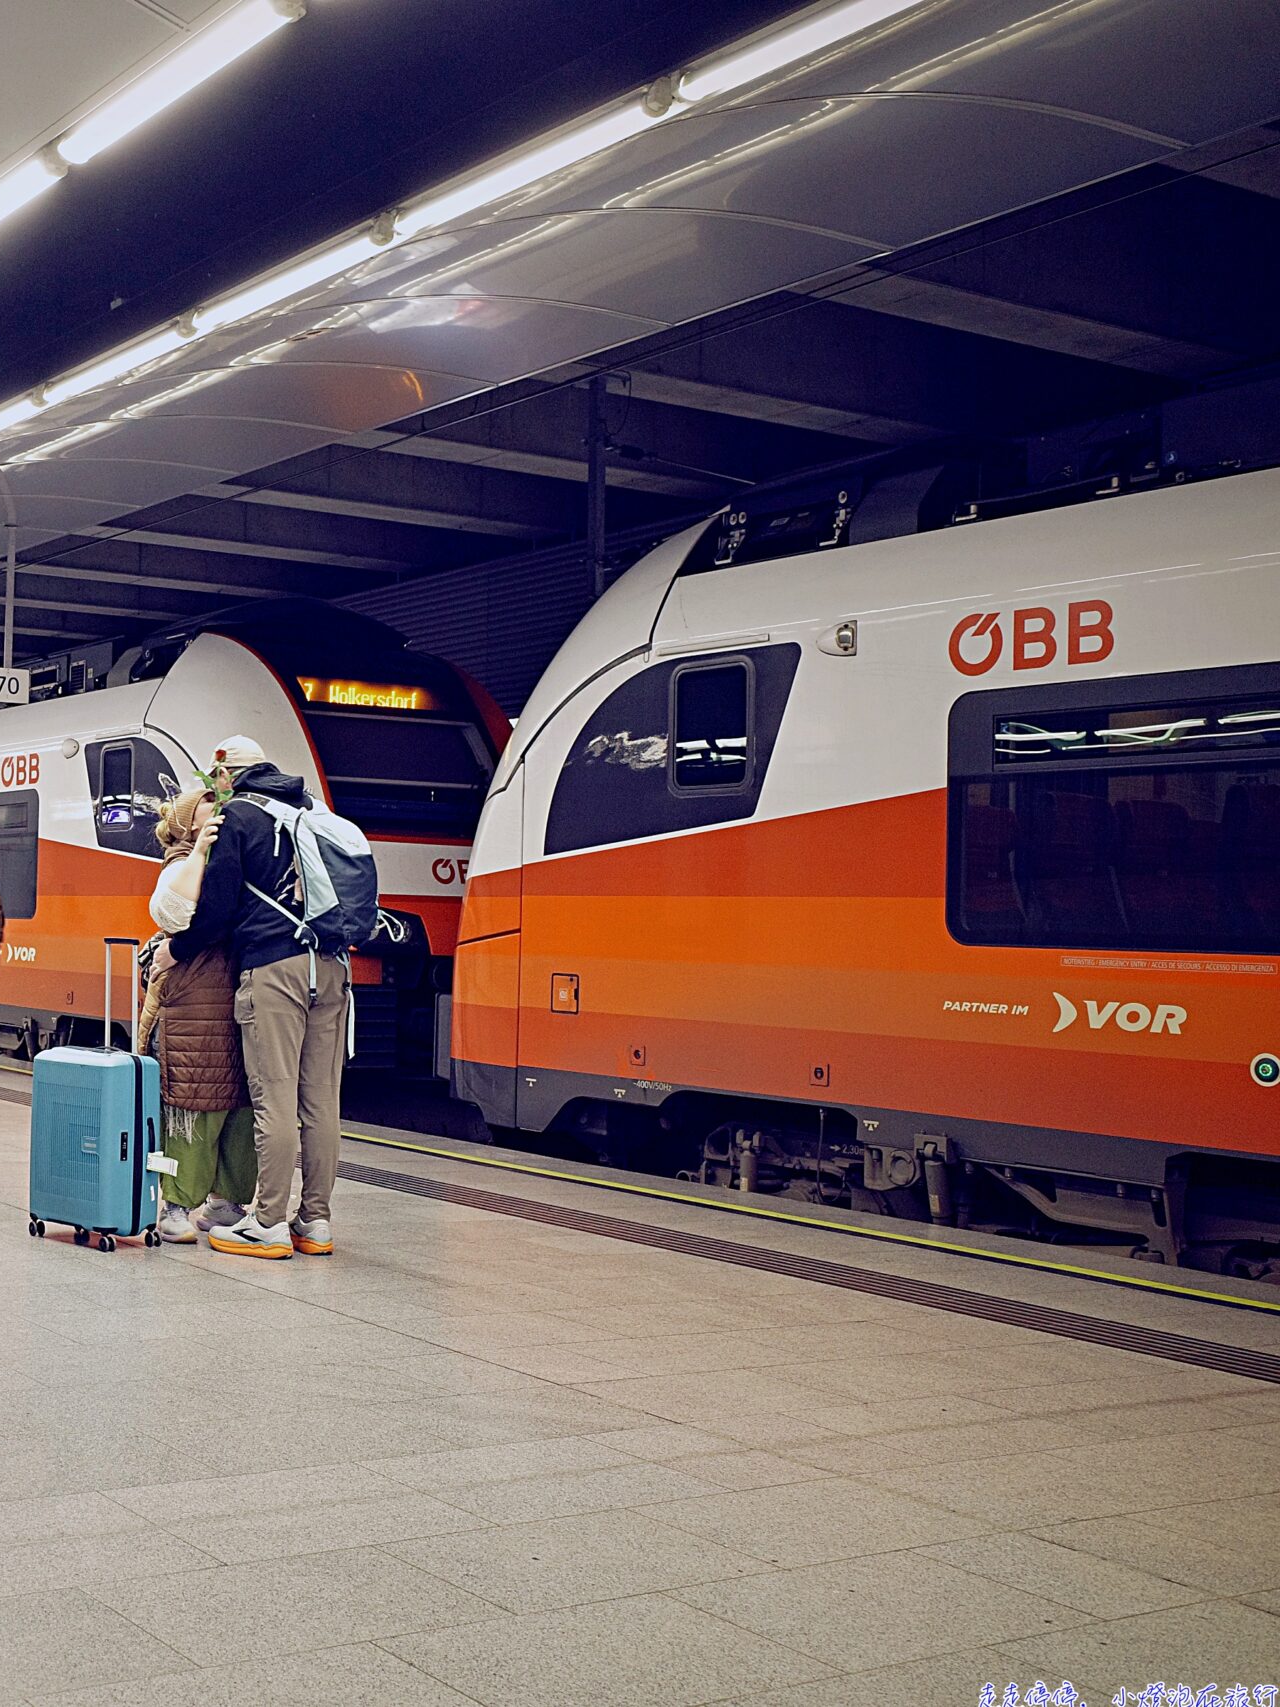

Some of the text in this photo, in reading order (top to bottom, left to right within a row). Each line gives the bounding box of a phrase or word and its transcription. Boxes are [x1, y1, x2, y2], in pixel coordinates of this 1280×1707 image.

[948, 599, 1115, 677] ÖBB
[329, 684, 418, 710] Wolkersdorf
[1, 752, 40, 788] ÖBB
[13, 945, 36, 962] VOR
[1099, 959, 1129, 967] EMERGENCY
[1239, 964, 1274, 972] EMERGENZA
[942, 1001, 1029, 1016] PARTNER IM
[1083, 1000, 1188, 1035] VOR
